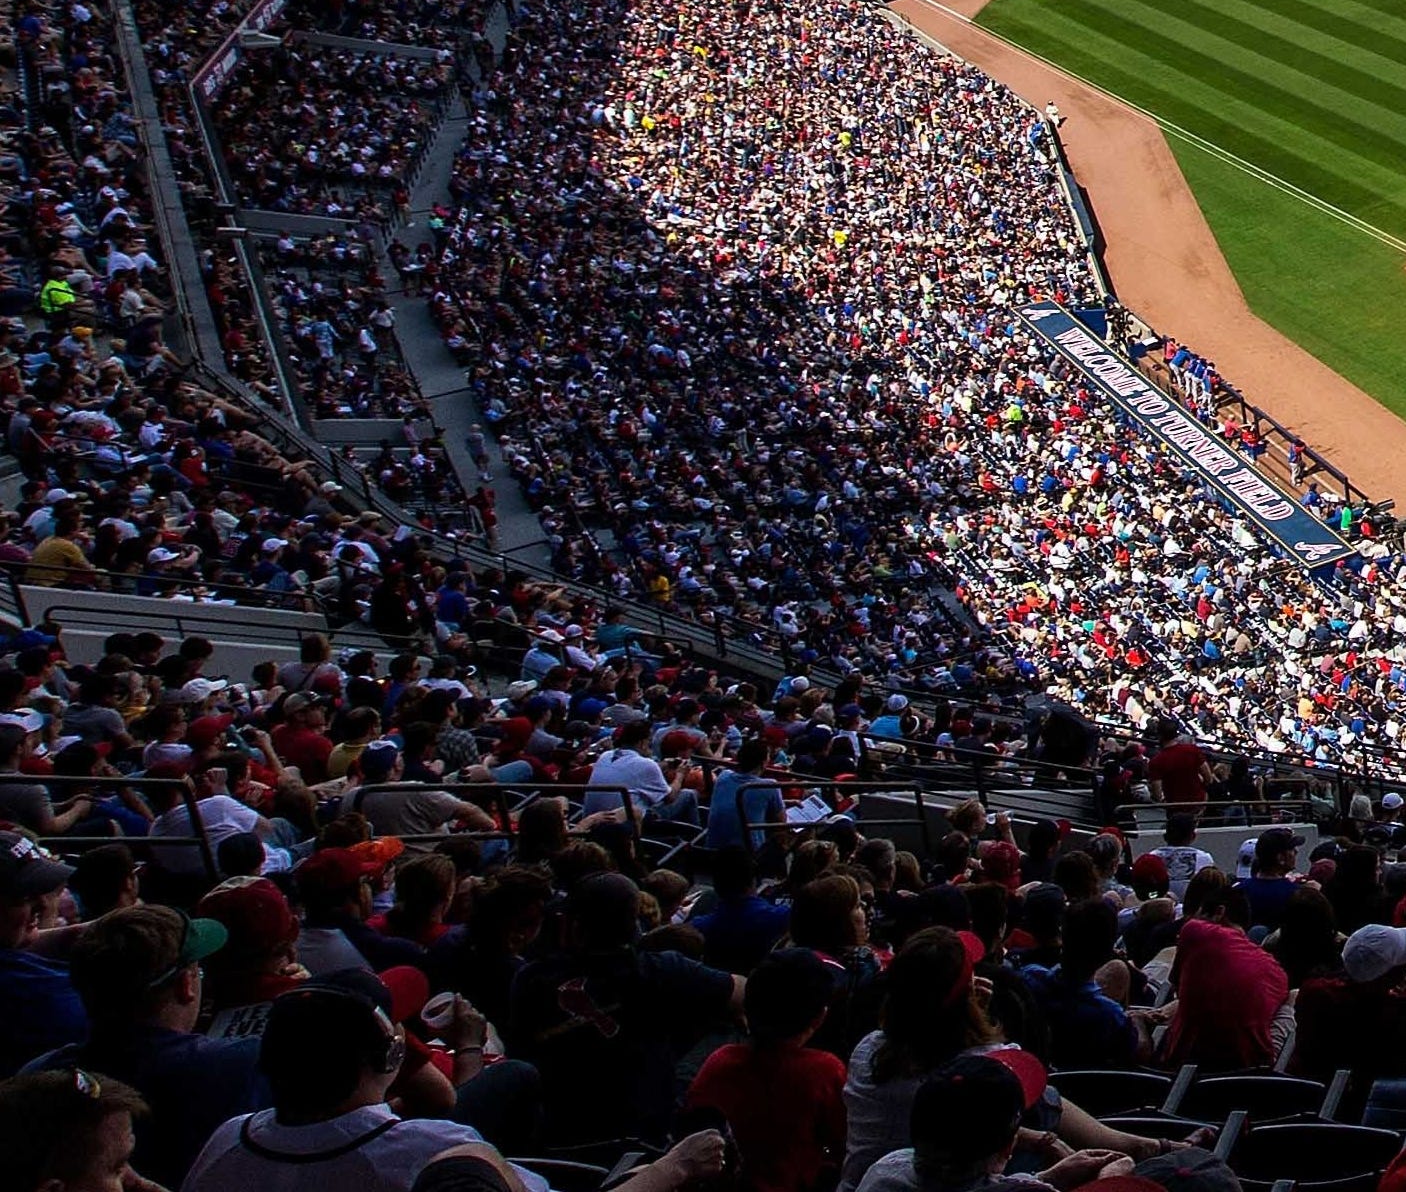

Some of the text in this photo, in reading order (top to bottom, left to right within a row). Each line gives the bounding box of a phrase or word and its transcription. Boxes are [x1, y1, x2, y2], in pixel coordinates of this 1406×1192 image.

[1053, 327, 1295, 522] WELCOME TO TURNER FIELD
